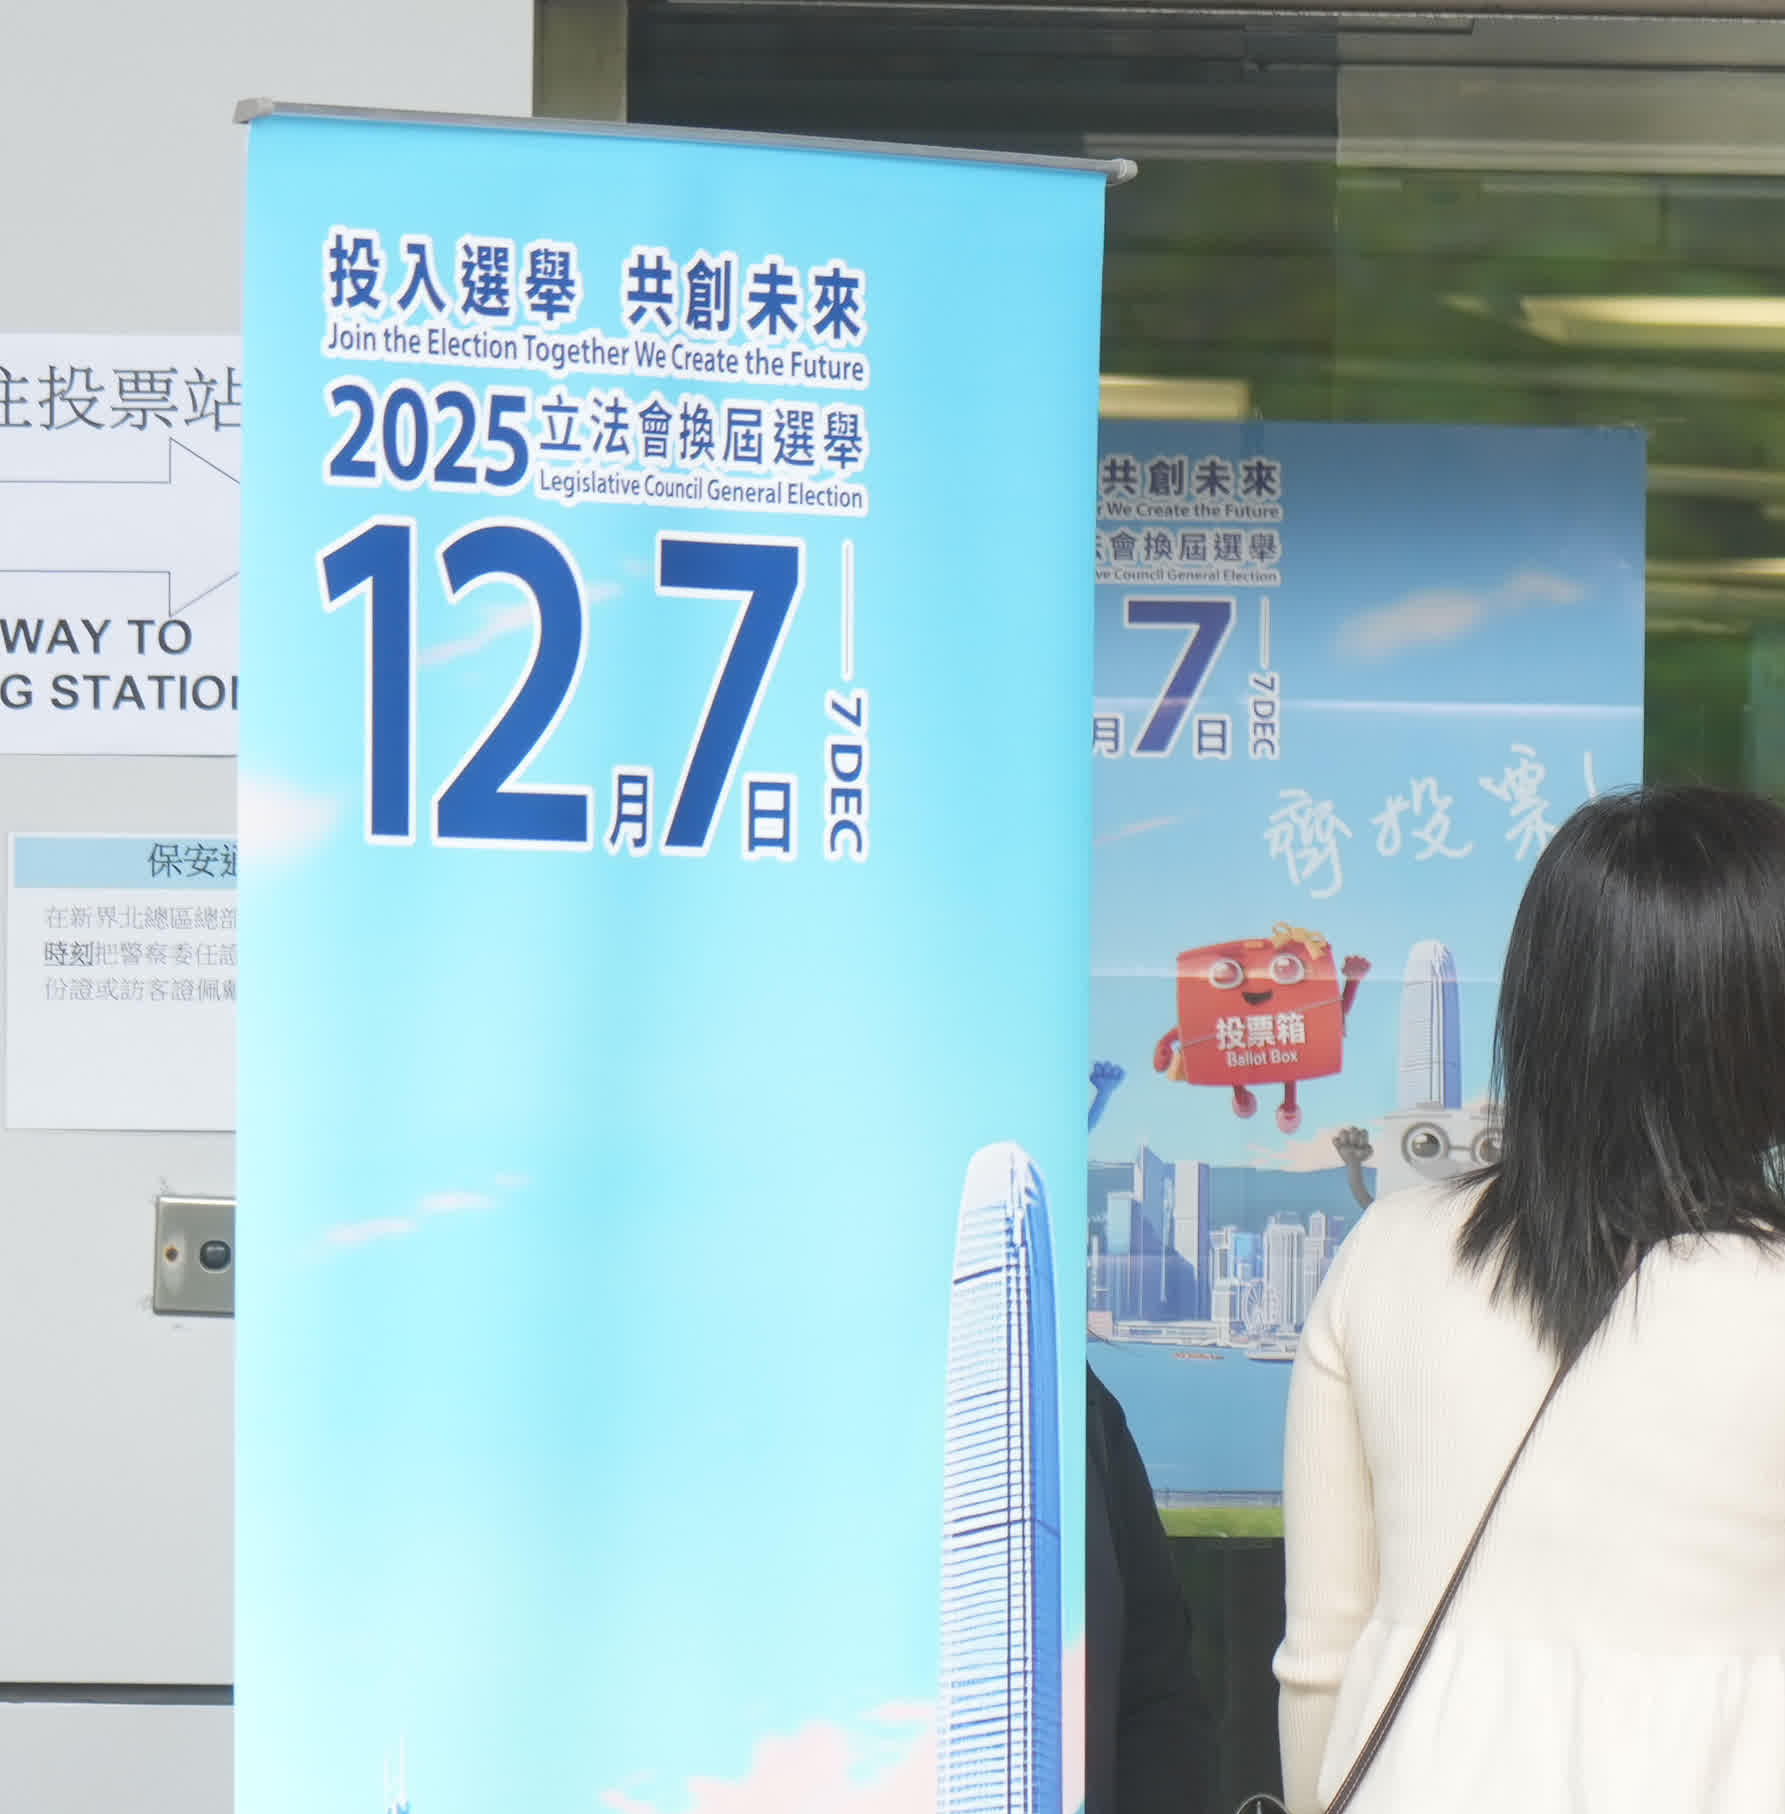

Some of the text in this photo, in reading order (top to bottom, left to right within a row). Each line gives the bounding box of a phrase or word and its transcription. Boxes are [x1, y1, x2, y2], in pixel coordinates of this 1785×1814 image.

[329, 234, 861, 340] 投入選舉 共創未來
[328, 322, 864, 381] Join the Election Together We Create the Future
[330, 385, 863, 486] 2025 立法會換屆選舉
[540, 470, 863, 509] Legislative Council General Election
[1102, 459, 1277, 496] 共創未來
[1107, 502, 1133, 517] We
[1136, 502, 1190, 518] Create
[1194, 503, 1220, 518] the
[1225, 503, 1280, 519] Future
[1114, 568, 1164, 582] Council
[1167, 568, 1220, 582] General
[1223, 569, 1278, 582] Election
[0, 618, 192, 655] WAY TO
[1216, 1012, 1305, 1051] 投票箱
[1227, 1048, 1299, 1067] Ballot Box
